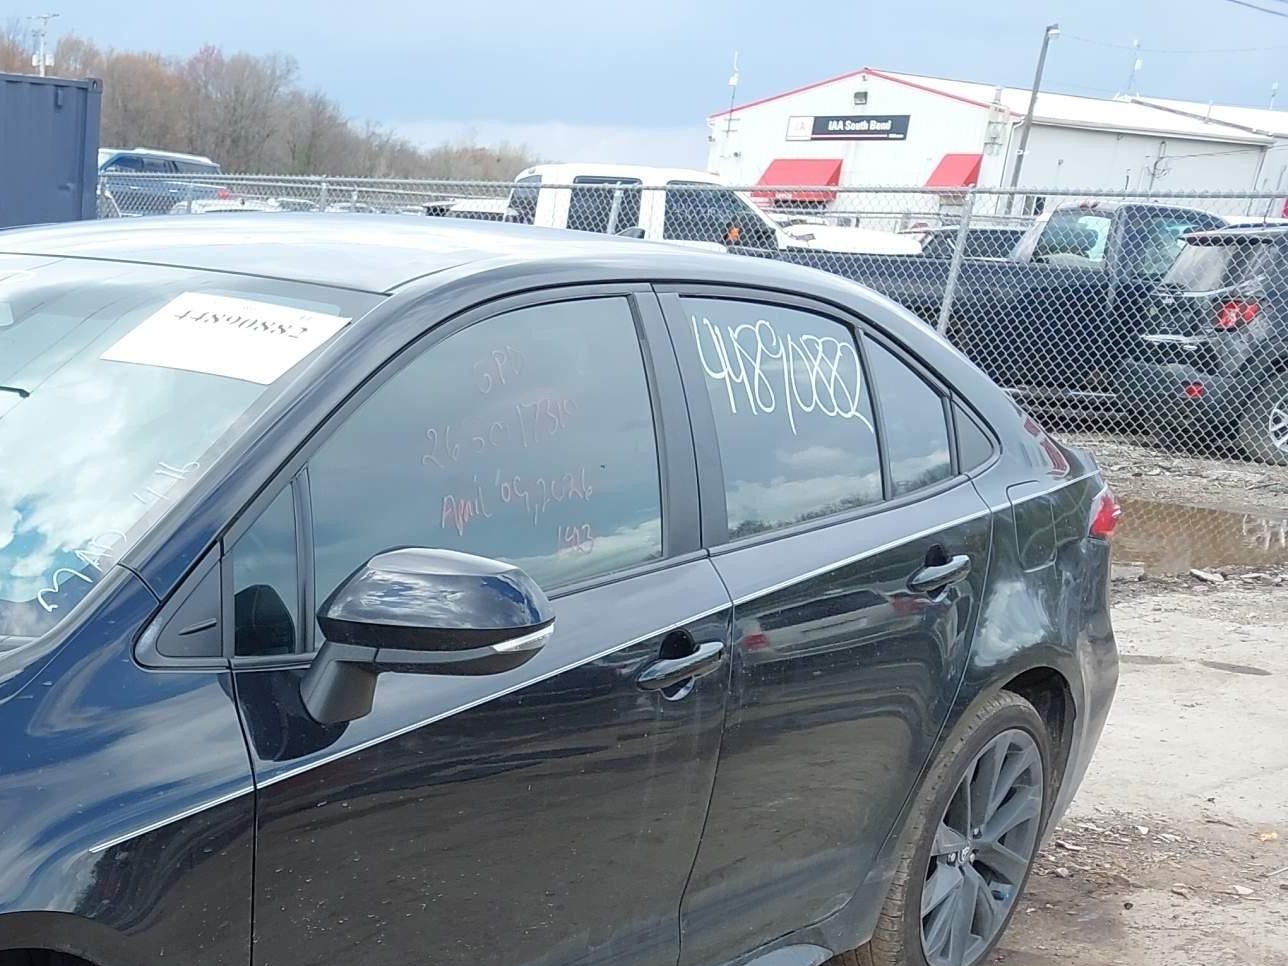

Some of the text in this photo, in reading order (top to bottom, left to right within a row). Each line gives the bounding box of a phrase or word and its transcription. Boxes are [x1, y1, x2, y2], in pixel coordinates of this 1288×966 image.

[827, 119, 892, 131] IAA South Bend
[441, 473, 493, 537] April
